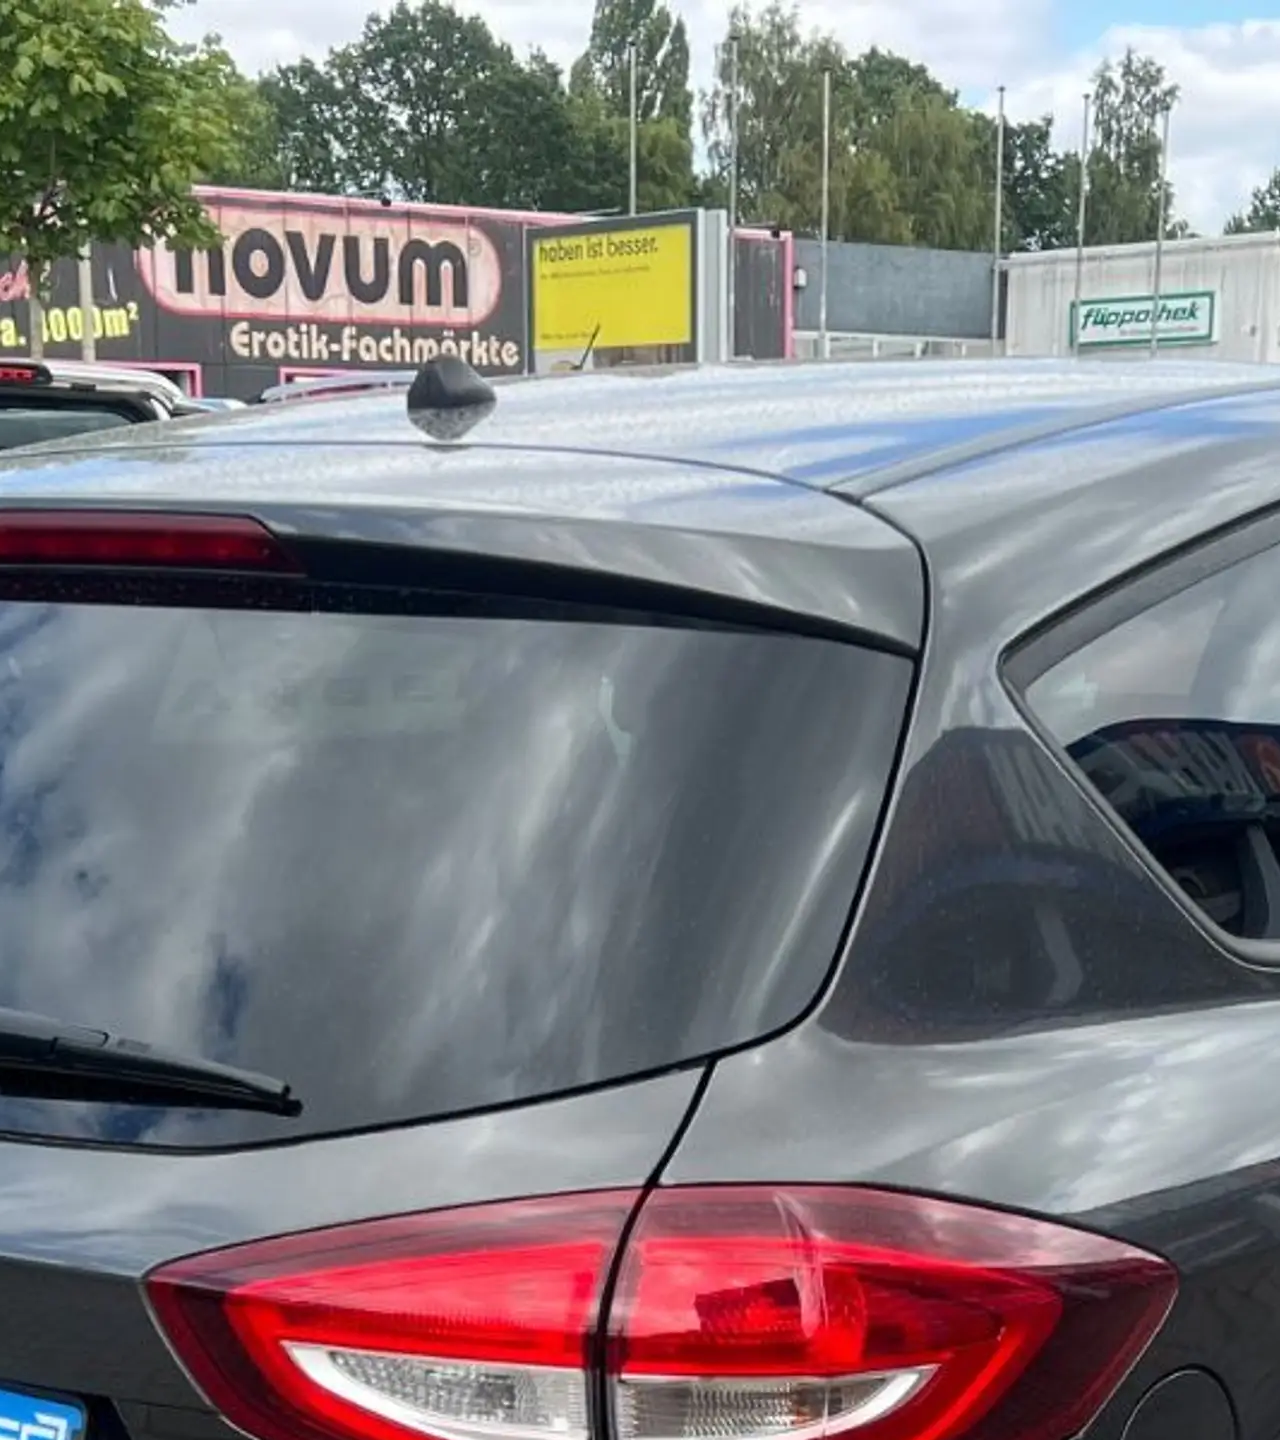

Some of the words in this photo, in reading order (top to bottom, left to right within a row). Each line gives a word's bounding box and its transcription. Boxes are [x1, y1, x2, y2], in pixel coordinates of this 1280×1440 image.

[538, 237, 584, 262] haben
[586, 236, 604, 258] ist
[606, 235, 659, 257] besser.
[175, 228, 468, 308] novum
[1081, 301, 1201, 331] flippohek
[230, 321, 519, 367] Erotik-Fachmärkte
